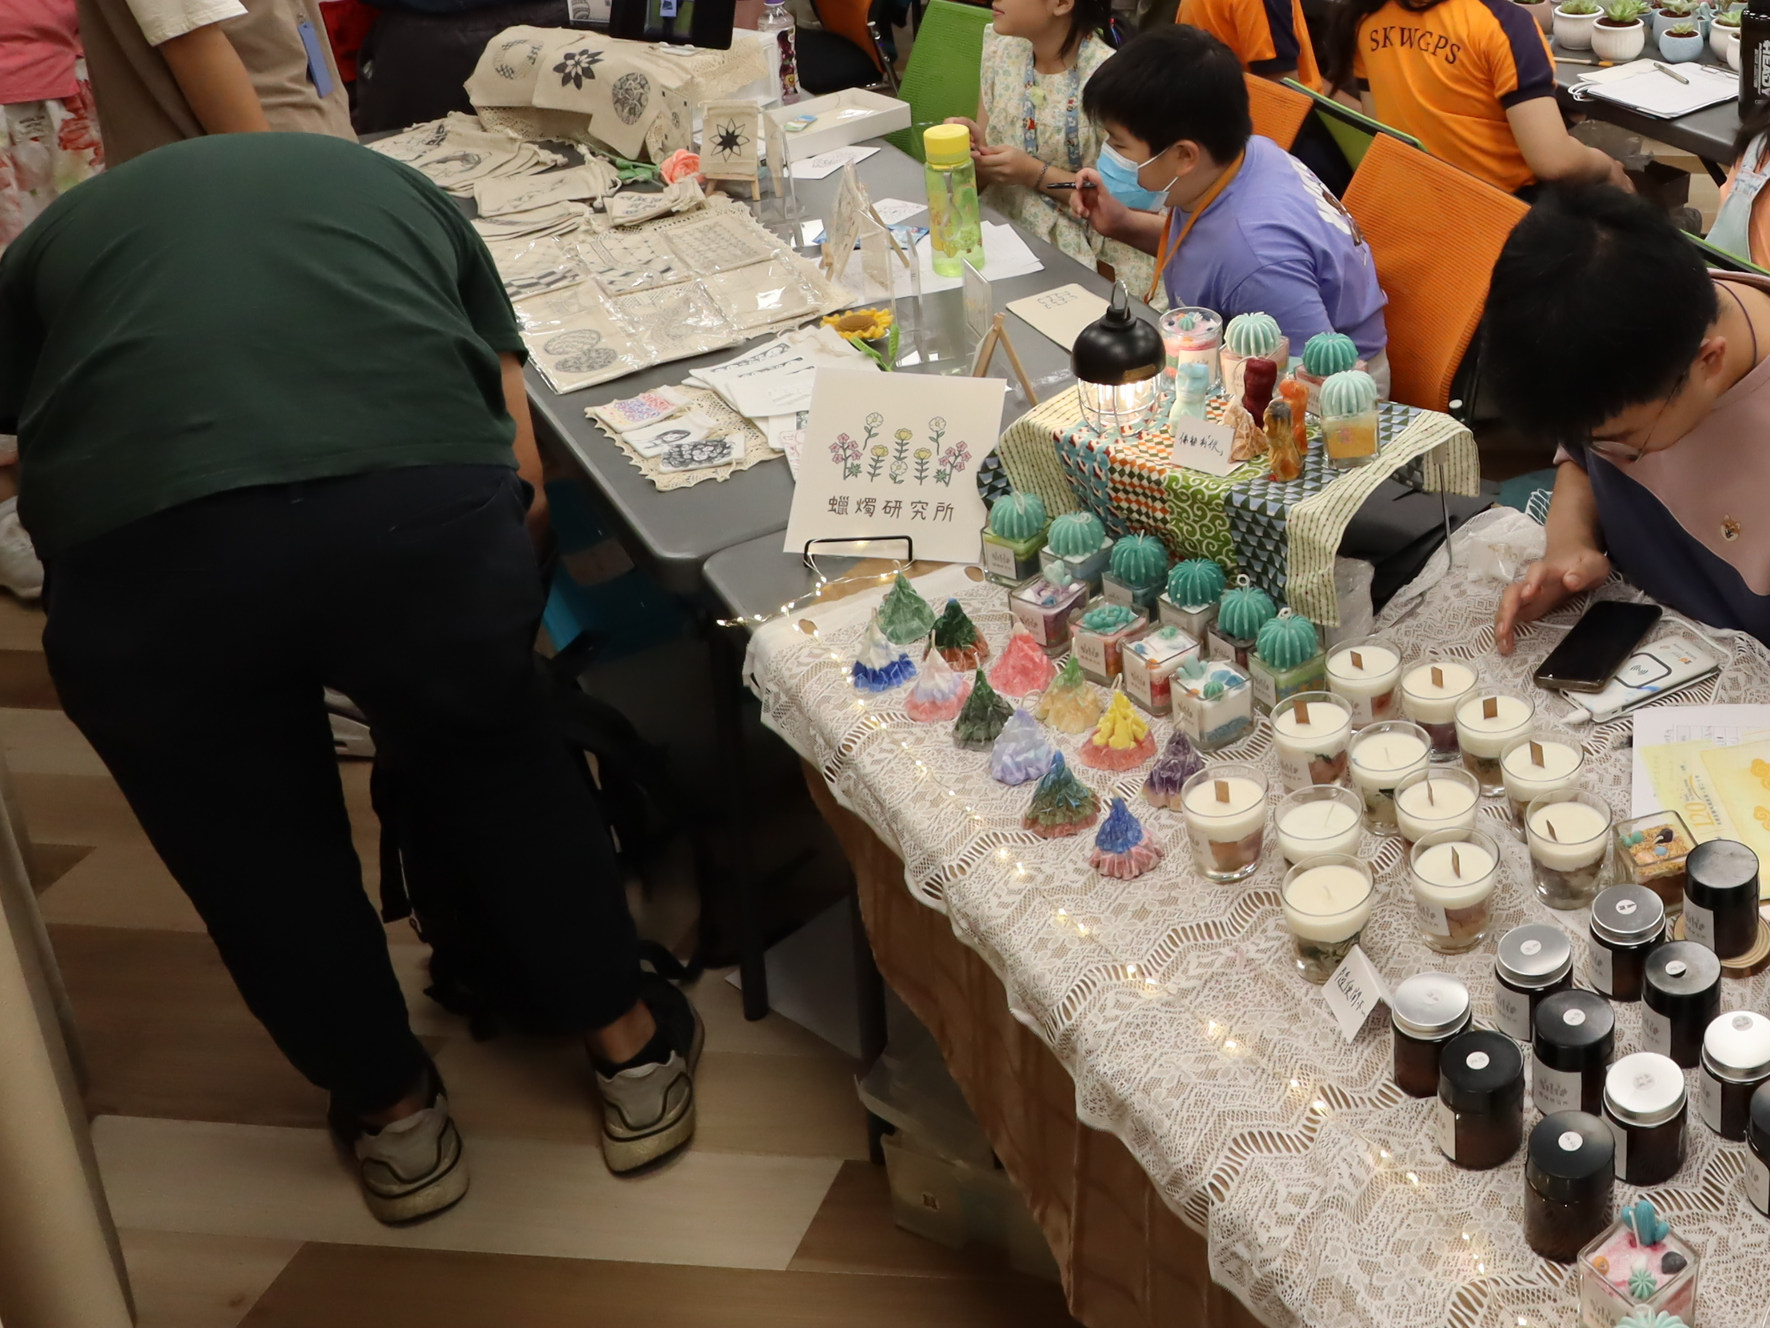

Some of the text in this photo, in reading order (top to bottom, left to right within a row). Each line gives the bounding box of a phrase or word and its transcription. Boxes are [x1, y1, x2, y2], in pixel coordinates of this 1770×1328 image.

[1369, 26, 1461, 65] SKWGPS
[828, 495, 955, 522] 蠟燭研究所
